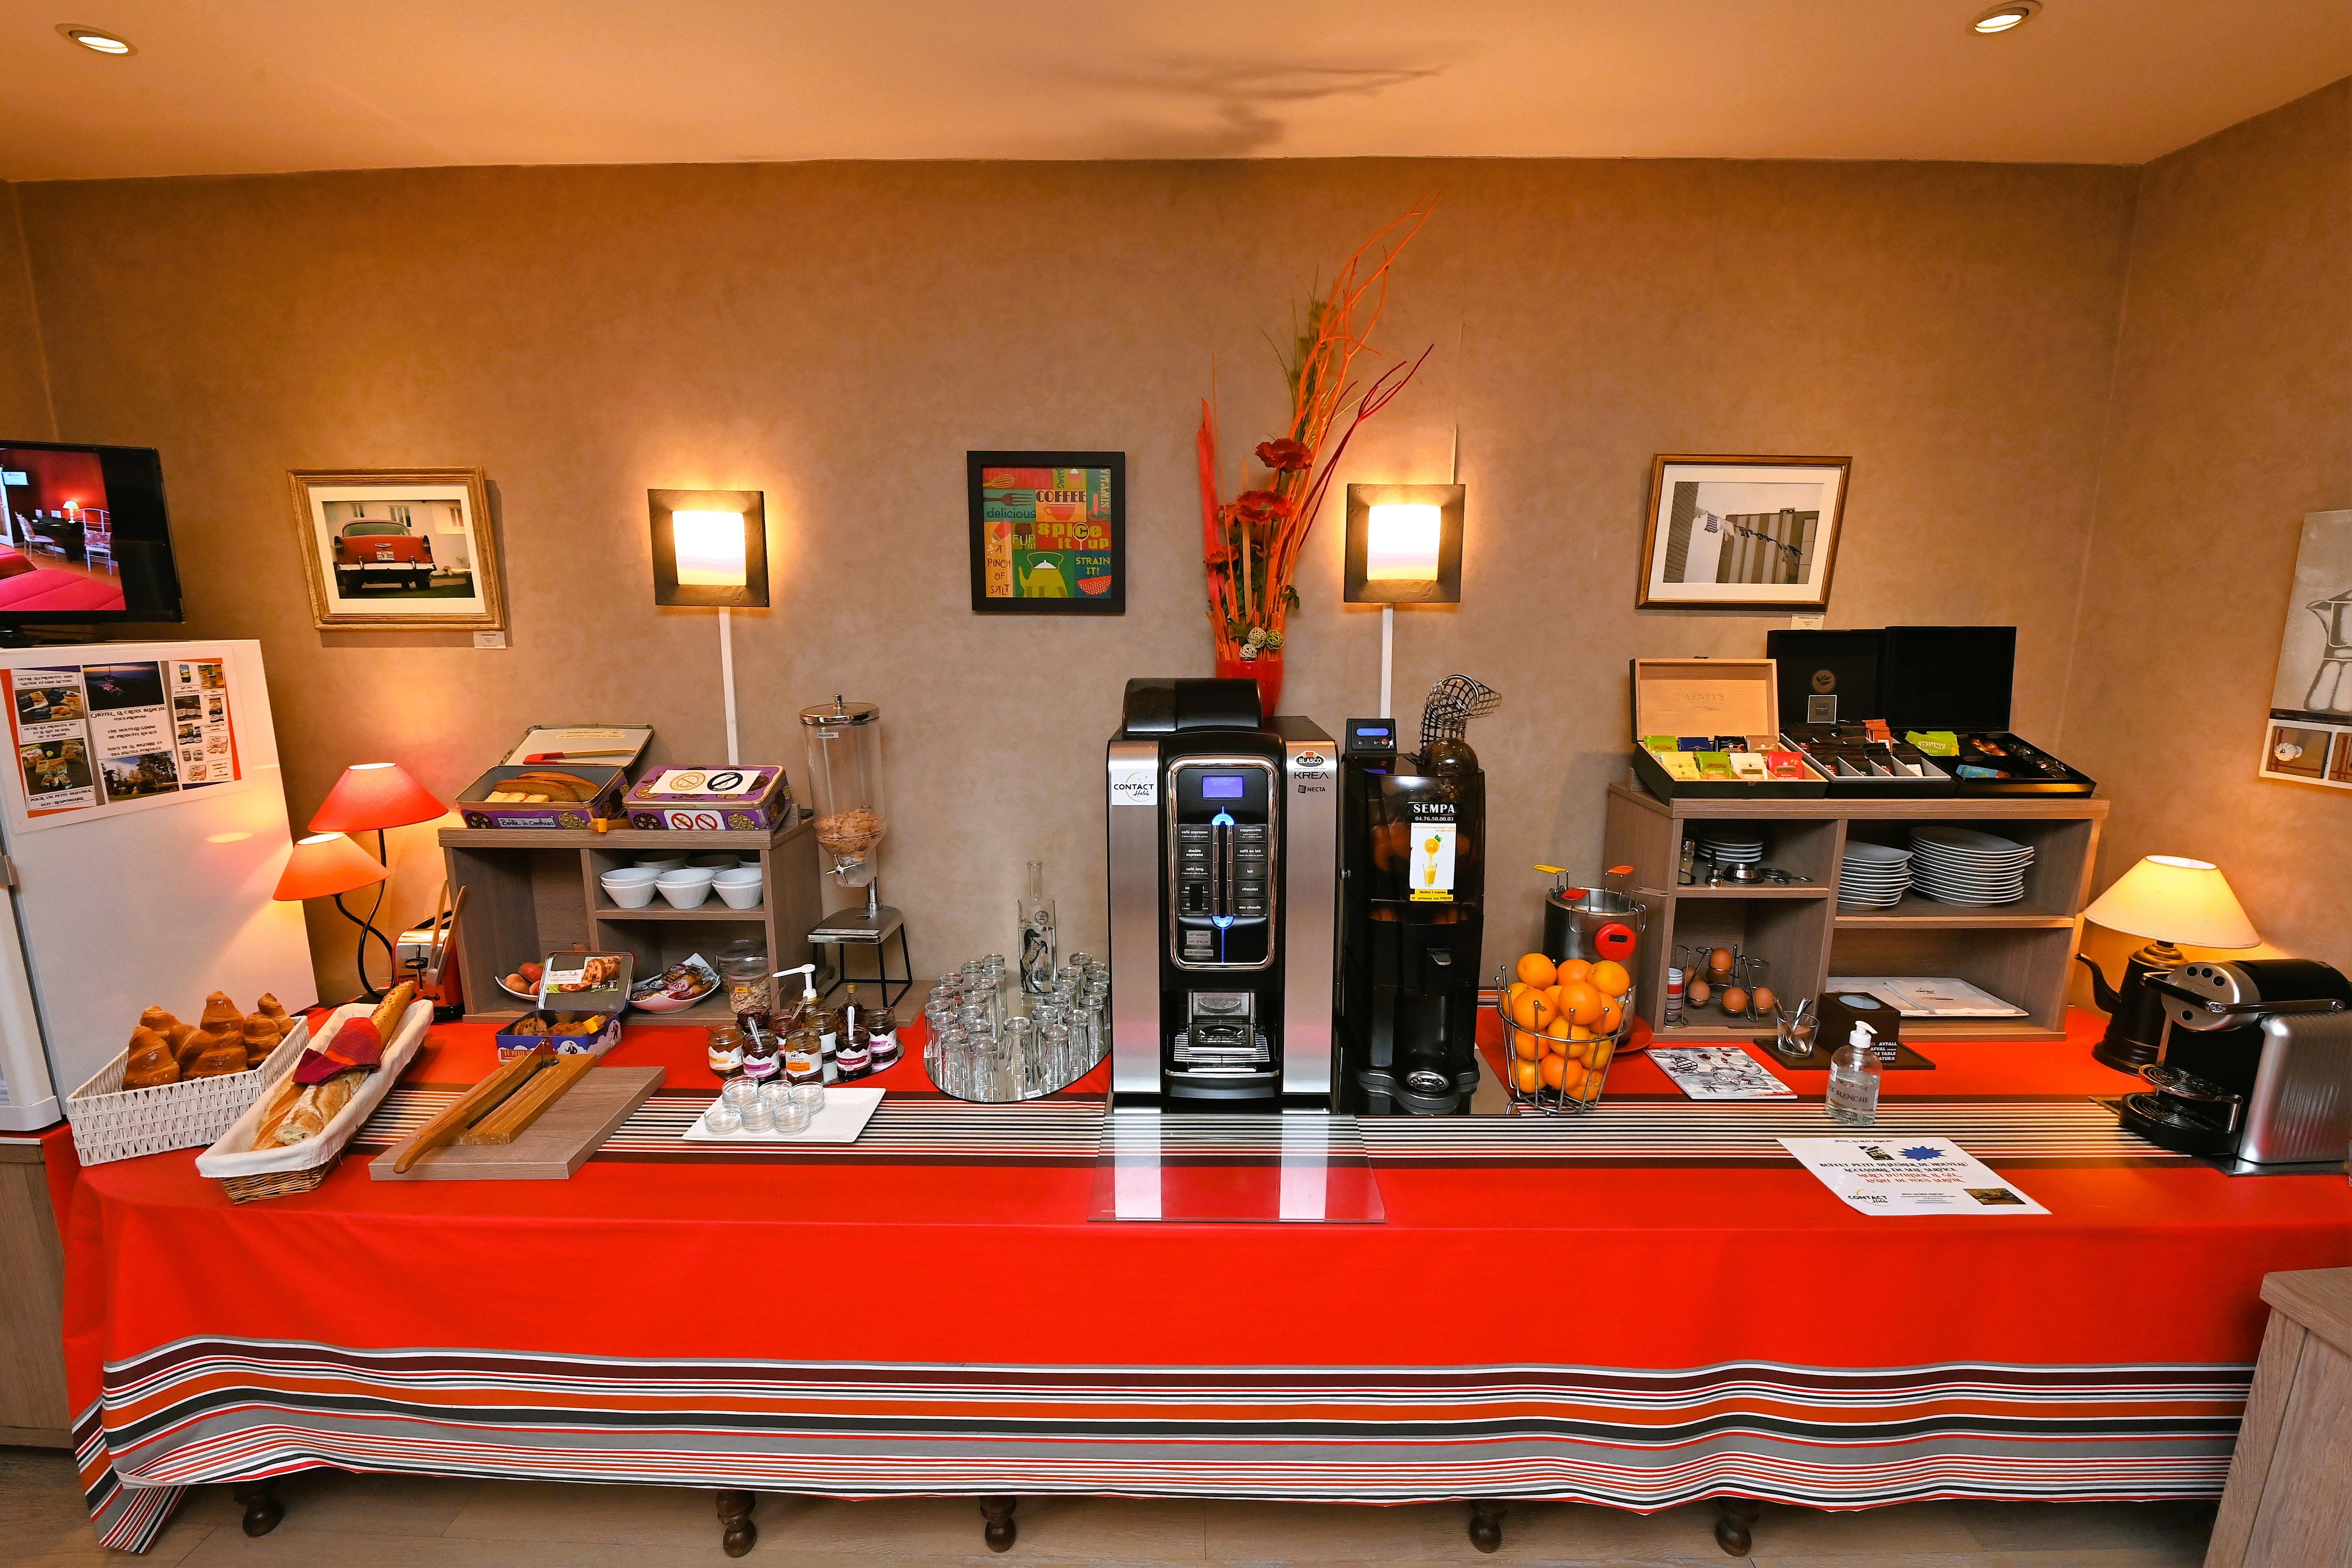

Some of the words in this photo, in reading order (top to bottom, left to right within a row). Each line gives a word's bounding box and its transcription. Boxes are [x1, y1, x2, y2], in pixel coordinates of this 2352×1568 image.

[1100, 469, 1110, 507] VITAMIN
[1036, 490, 1086, 502] COFFEE
[987, 508, 1036, 519] delicious
[1037, 523, 1102, 537] spice
[1013, 534, 1035, 545] FLIP
[1059, 536, 1071, 549] it
[1088, 538, 1109, 549] up
[996, 544, 1002, 553] A
[988, 558, 1010, 568] PINCH
[1076, 557, 1110, 565] STRAIN
[994, 572, 1005, 580] OF
[991, 584, 1010, 595] SALT
[1413, 804, 1455, 813] SEMPA
[1836, 1090, 1868, 1102] BLANCHE
